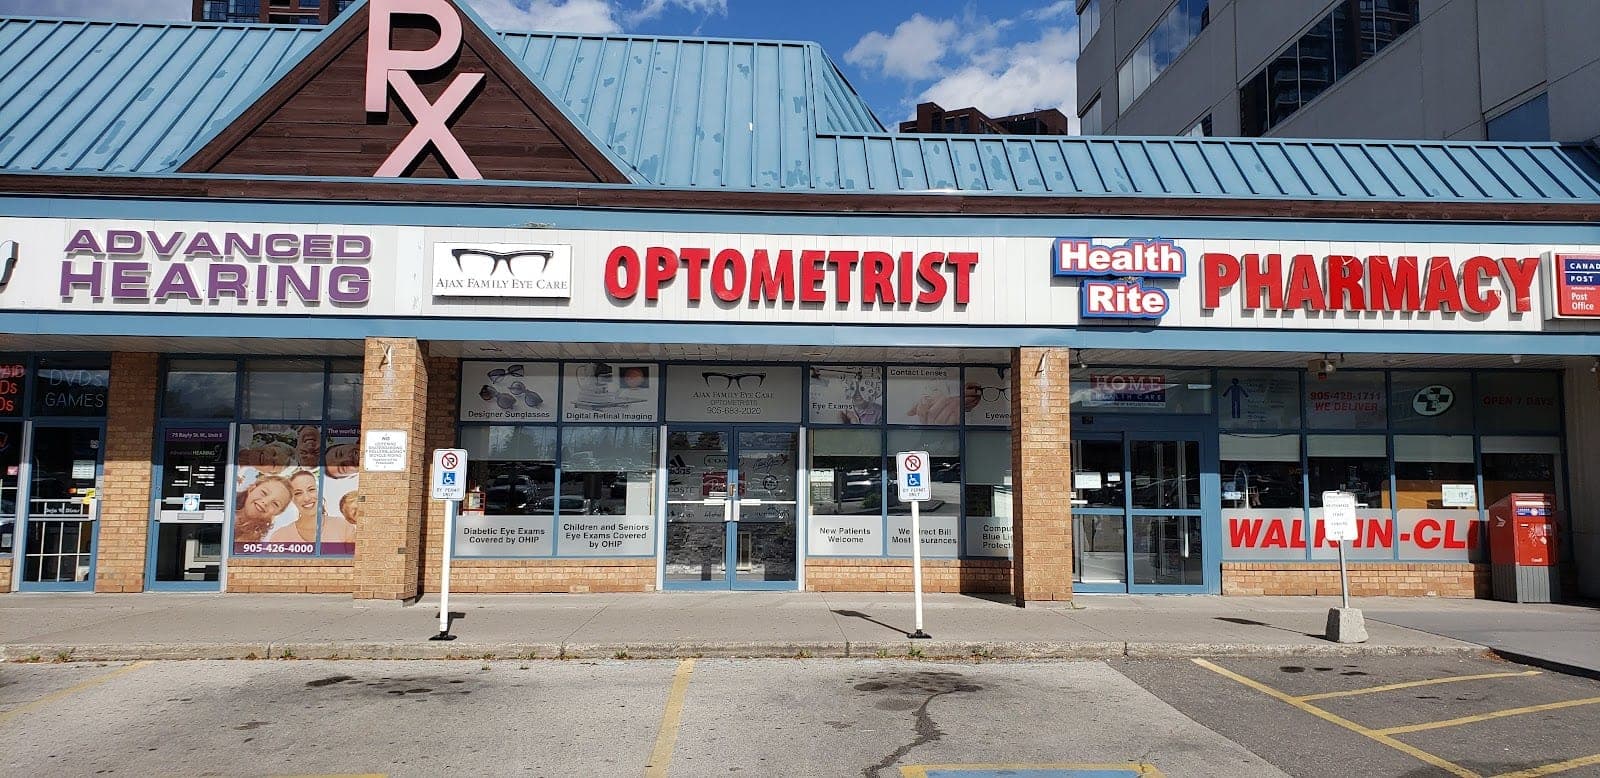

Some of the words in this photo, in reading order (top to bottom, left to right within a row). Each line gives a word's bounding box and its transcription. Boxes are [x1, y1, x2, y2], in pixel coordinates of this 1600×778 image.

[64, 229, 373, 260] ADVANCED
[1060, 239, 1185, 274] Health
[1569, 262, 1600, 270] CANAD
[604, 245, 979, 305] OPTOMETRIST
[59, 260, 372, 303] HEARING
[466, 278, 509, 289] FAMILY
[512, 278, 533, 289] EYE
[536, 279, 568, 290] CARE
[1201, 252, 1540, 314] PHARMACY
[1087, 282, 1167, 314] Rite
[1571, 292, 1588, 301] Post
[1571, 302, 1595, 310] Office
[49, 369, 104, 386] DVDs
[1094, 375, 1161, 391] HOME
[45, 392, 105, 408] GAMES
[812, 402, 825, 410] Eye
[828, 402, 853, 410] Exams
[1334, 402, 1378, 411] DELIVER
[468, 410, 503, 419] Designer
[505, 411, 550, 419] Sunglasses
[566, 412, 591, 420] Digital
[593, 412, 620, 420] Retinal
[622, 412, 653, 421] Imaging
[985, 412, 1011, 420] Eyewe
[463, 527, 498, 535] Diabetic
[500, 527, 516, 536] Eye
[518, 527, 545, 535] Exams
[563, 523, 598, 531] Children
[600, 523, 616, 531] and
[618, 523, 649, 531] Seniors
[839, 527, 871, 535] Patients
[898, 527, 911, 535] We
[938, 528, 952, 536] Bill
[983, 524, 1012, 533] Compu
[505, 536, 516, 544] by
[565, 532, 581, 540] Eye
[827, 535, 864, 543] Welcome
[891, 536, 911, 544] Most
[243, 543, 314, 553] 905-426-4000
[589, 540, 599, 549] by
[601, 540, 623, 548] OHIP
[982, 541, 1011, 549] Protect
